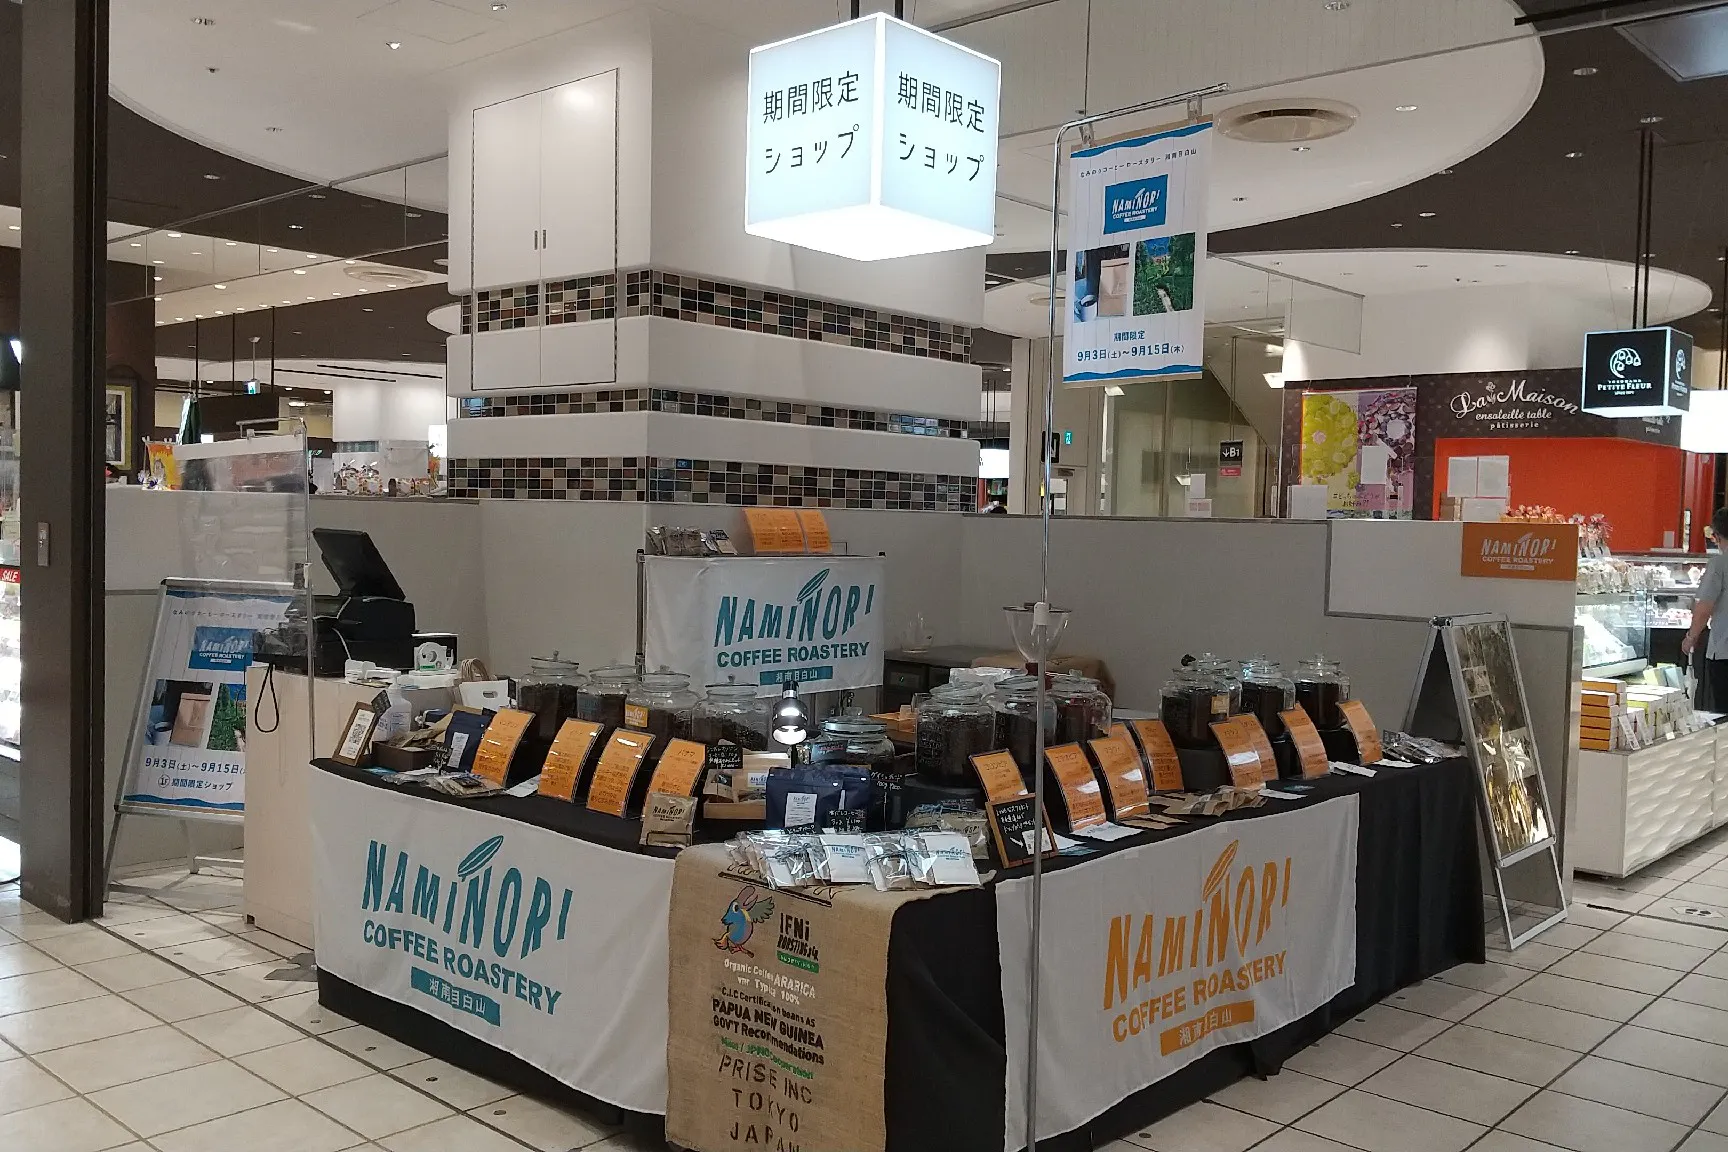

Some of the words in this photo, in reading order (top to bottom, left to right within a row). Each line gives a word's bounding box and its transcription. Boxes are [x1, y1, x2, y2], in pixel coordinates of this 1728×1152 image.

[763, 70, 859, 124] 期間限定
[897, 70, 985, 133] 期間限定
[765, 123, 860, 174] ショップ
[899, 132, 985, 181] ショップ
[1113, 330, 1146, 342] 期間限定
[1450, 391, 1488, 419] La
[1496, 379, 1579, 415] Maison
[1597, 383, 1625, 391] PETITE
[1626, 382, 1652, 390] FLEUR
[1526, 408, 1552, 419] table
[1229, 447, 1240, 457] B1
[1, 570, 18, 583] SALE
[1482, 556, 1512, 564] COFFEE
[1513, 557, 1554, 565] ROASTERY
[716, 651, 782, 668] COFFEE
[787, 641, 870, 663] ROASTERY
[171, 777, 234, 791] 期間限定ショップ
[363, 919, 439, 965] COFFEE
[443, 946, 563, 1016] ROASTERY
[724, 958, 752, 974] Organic
[429, 978, 486, 1015] 湘南目白山
[780, 990, 800, 1005] 100%
[1112, 986, 1187, 1043] COFFEE
[712, 998, 751, 1022] PAPUA
[754, 1009, 777, 1031] NEW
[779, 1021, 824, 1051] GUINEA
[718, 1053, 778, 1090] PRISE
[784, 1077, 813, 1105] INC
[732, 1088, 800, 1133] TOKYO
